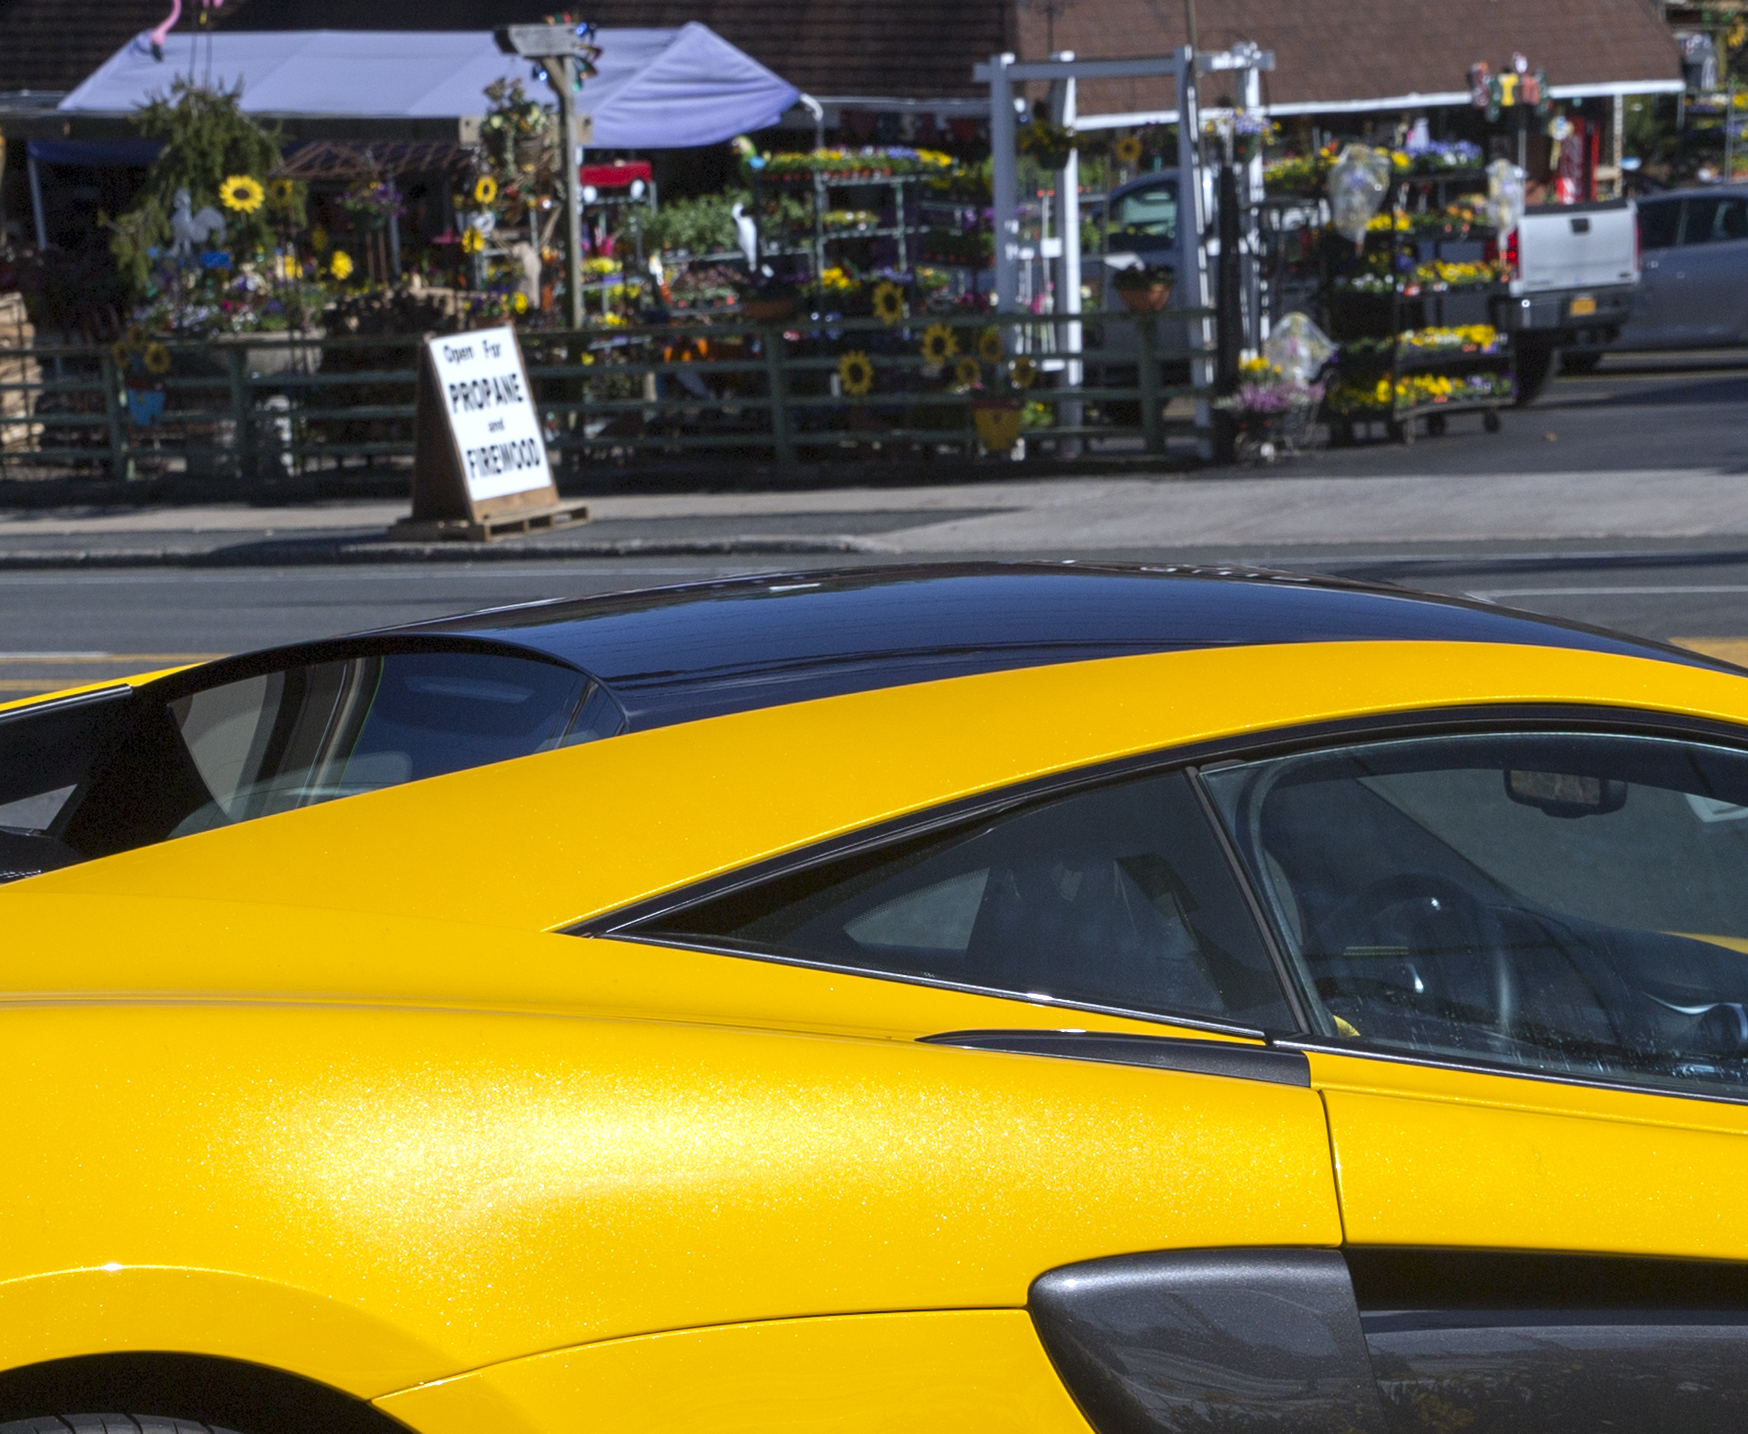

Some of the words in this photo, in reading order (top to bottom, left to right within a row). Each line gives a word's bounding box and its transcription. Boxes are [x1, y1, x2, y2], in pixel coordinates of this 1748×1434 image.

[443, 344, 475, 364] Open
[483, 340, 501, 360] For
[449, 373, 524, 414] PROPANE
[488, 418, 505, 433] and
[467, 438, 540, 479] FIREWOOD
